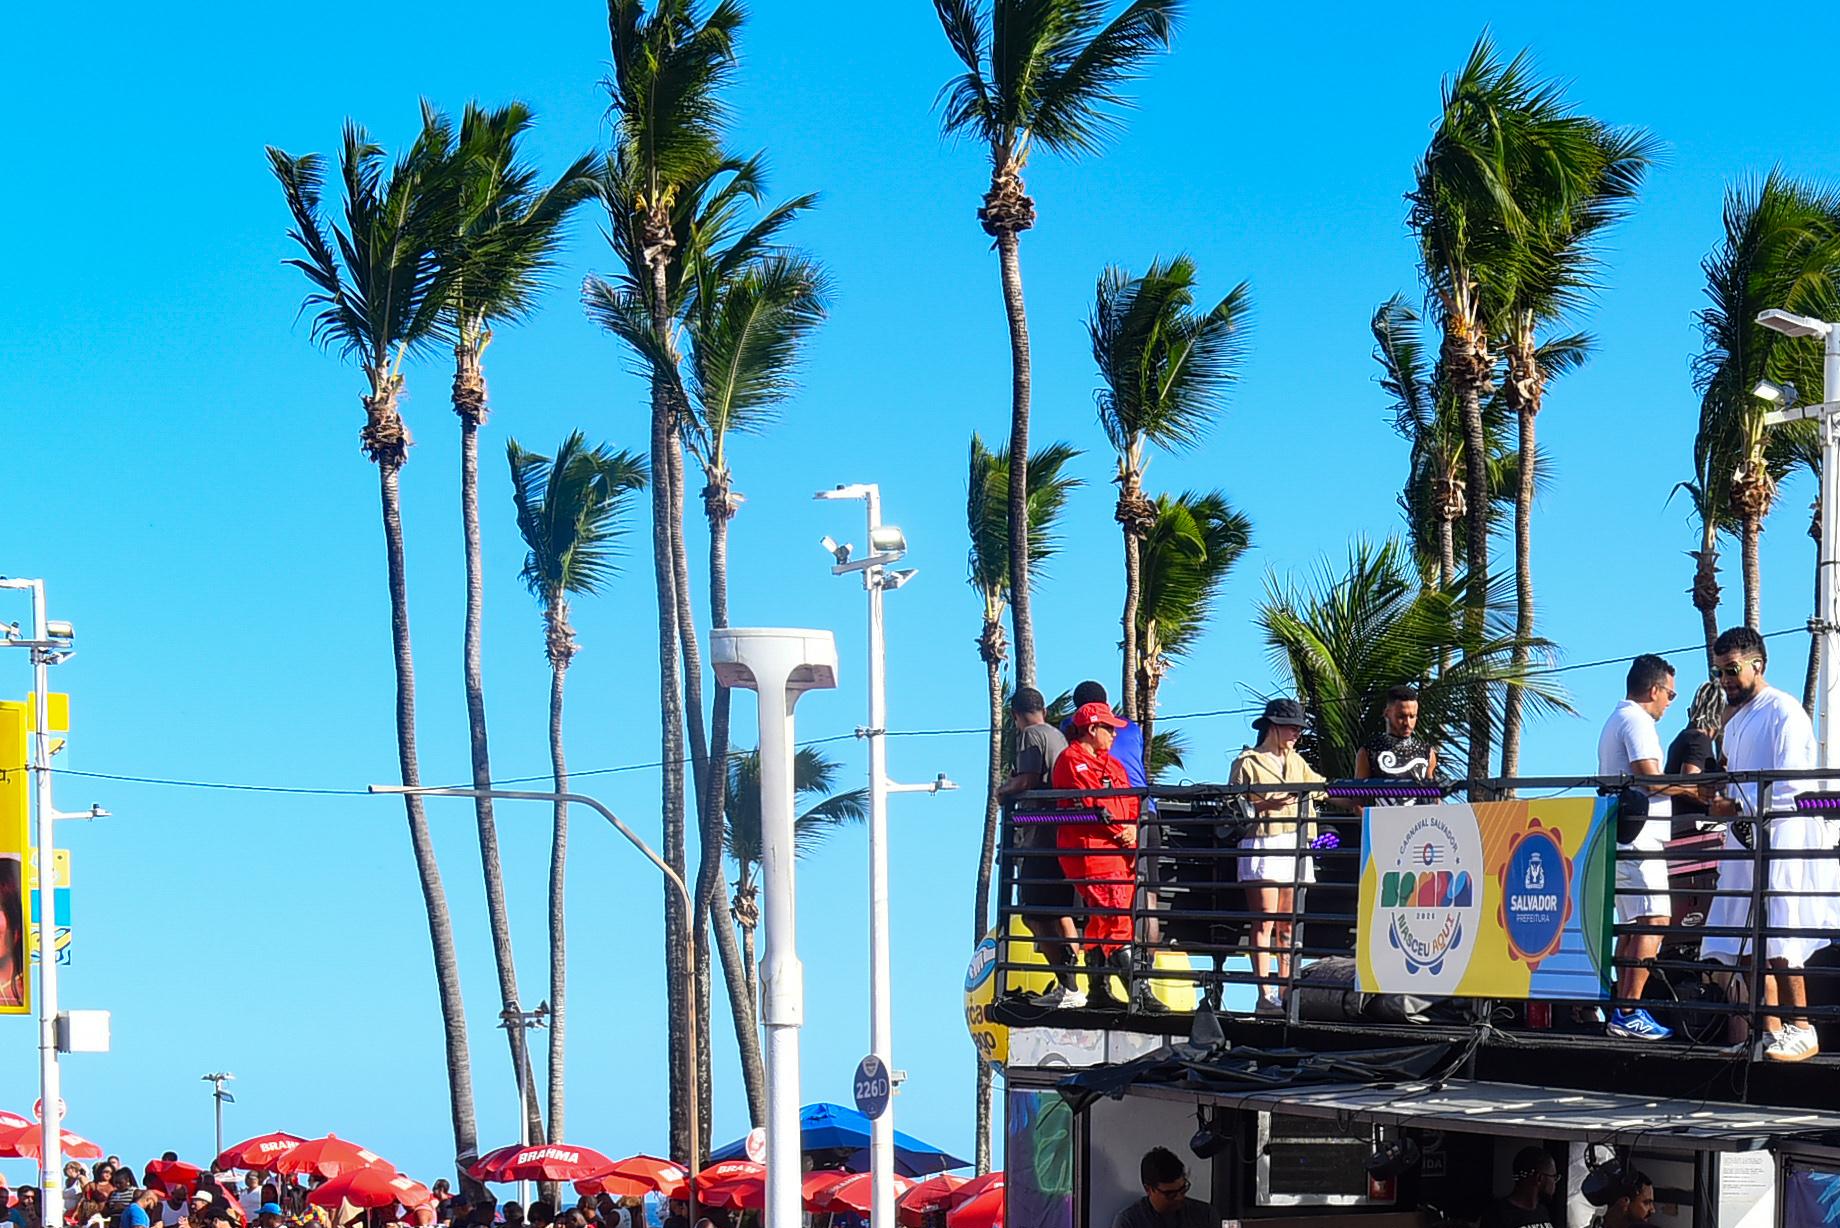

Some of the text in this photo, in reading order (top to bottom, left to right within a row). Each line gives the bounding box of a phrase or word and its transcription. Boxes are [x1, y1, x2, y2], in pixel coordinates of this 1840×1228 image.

[1400, 817, 1458, 855] CARNAVAL SALVADOR
[1510, 895, 1557, 912] SALVADOR
[1516, 913, 1550, 923] PREFEITURA
[1398, 913, 1455, 957] NASCEU AQUI
[856, 1078, 888, 1099] 226D
[517, 1148, 579, 1164] BRAHMA
